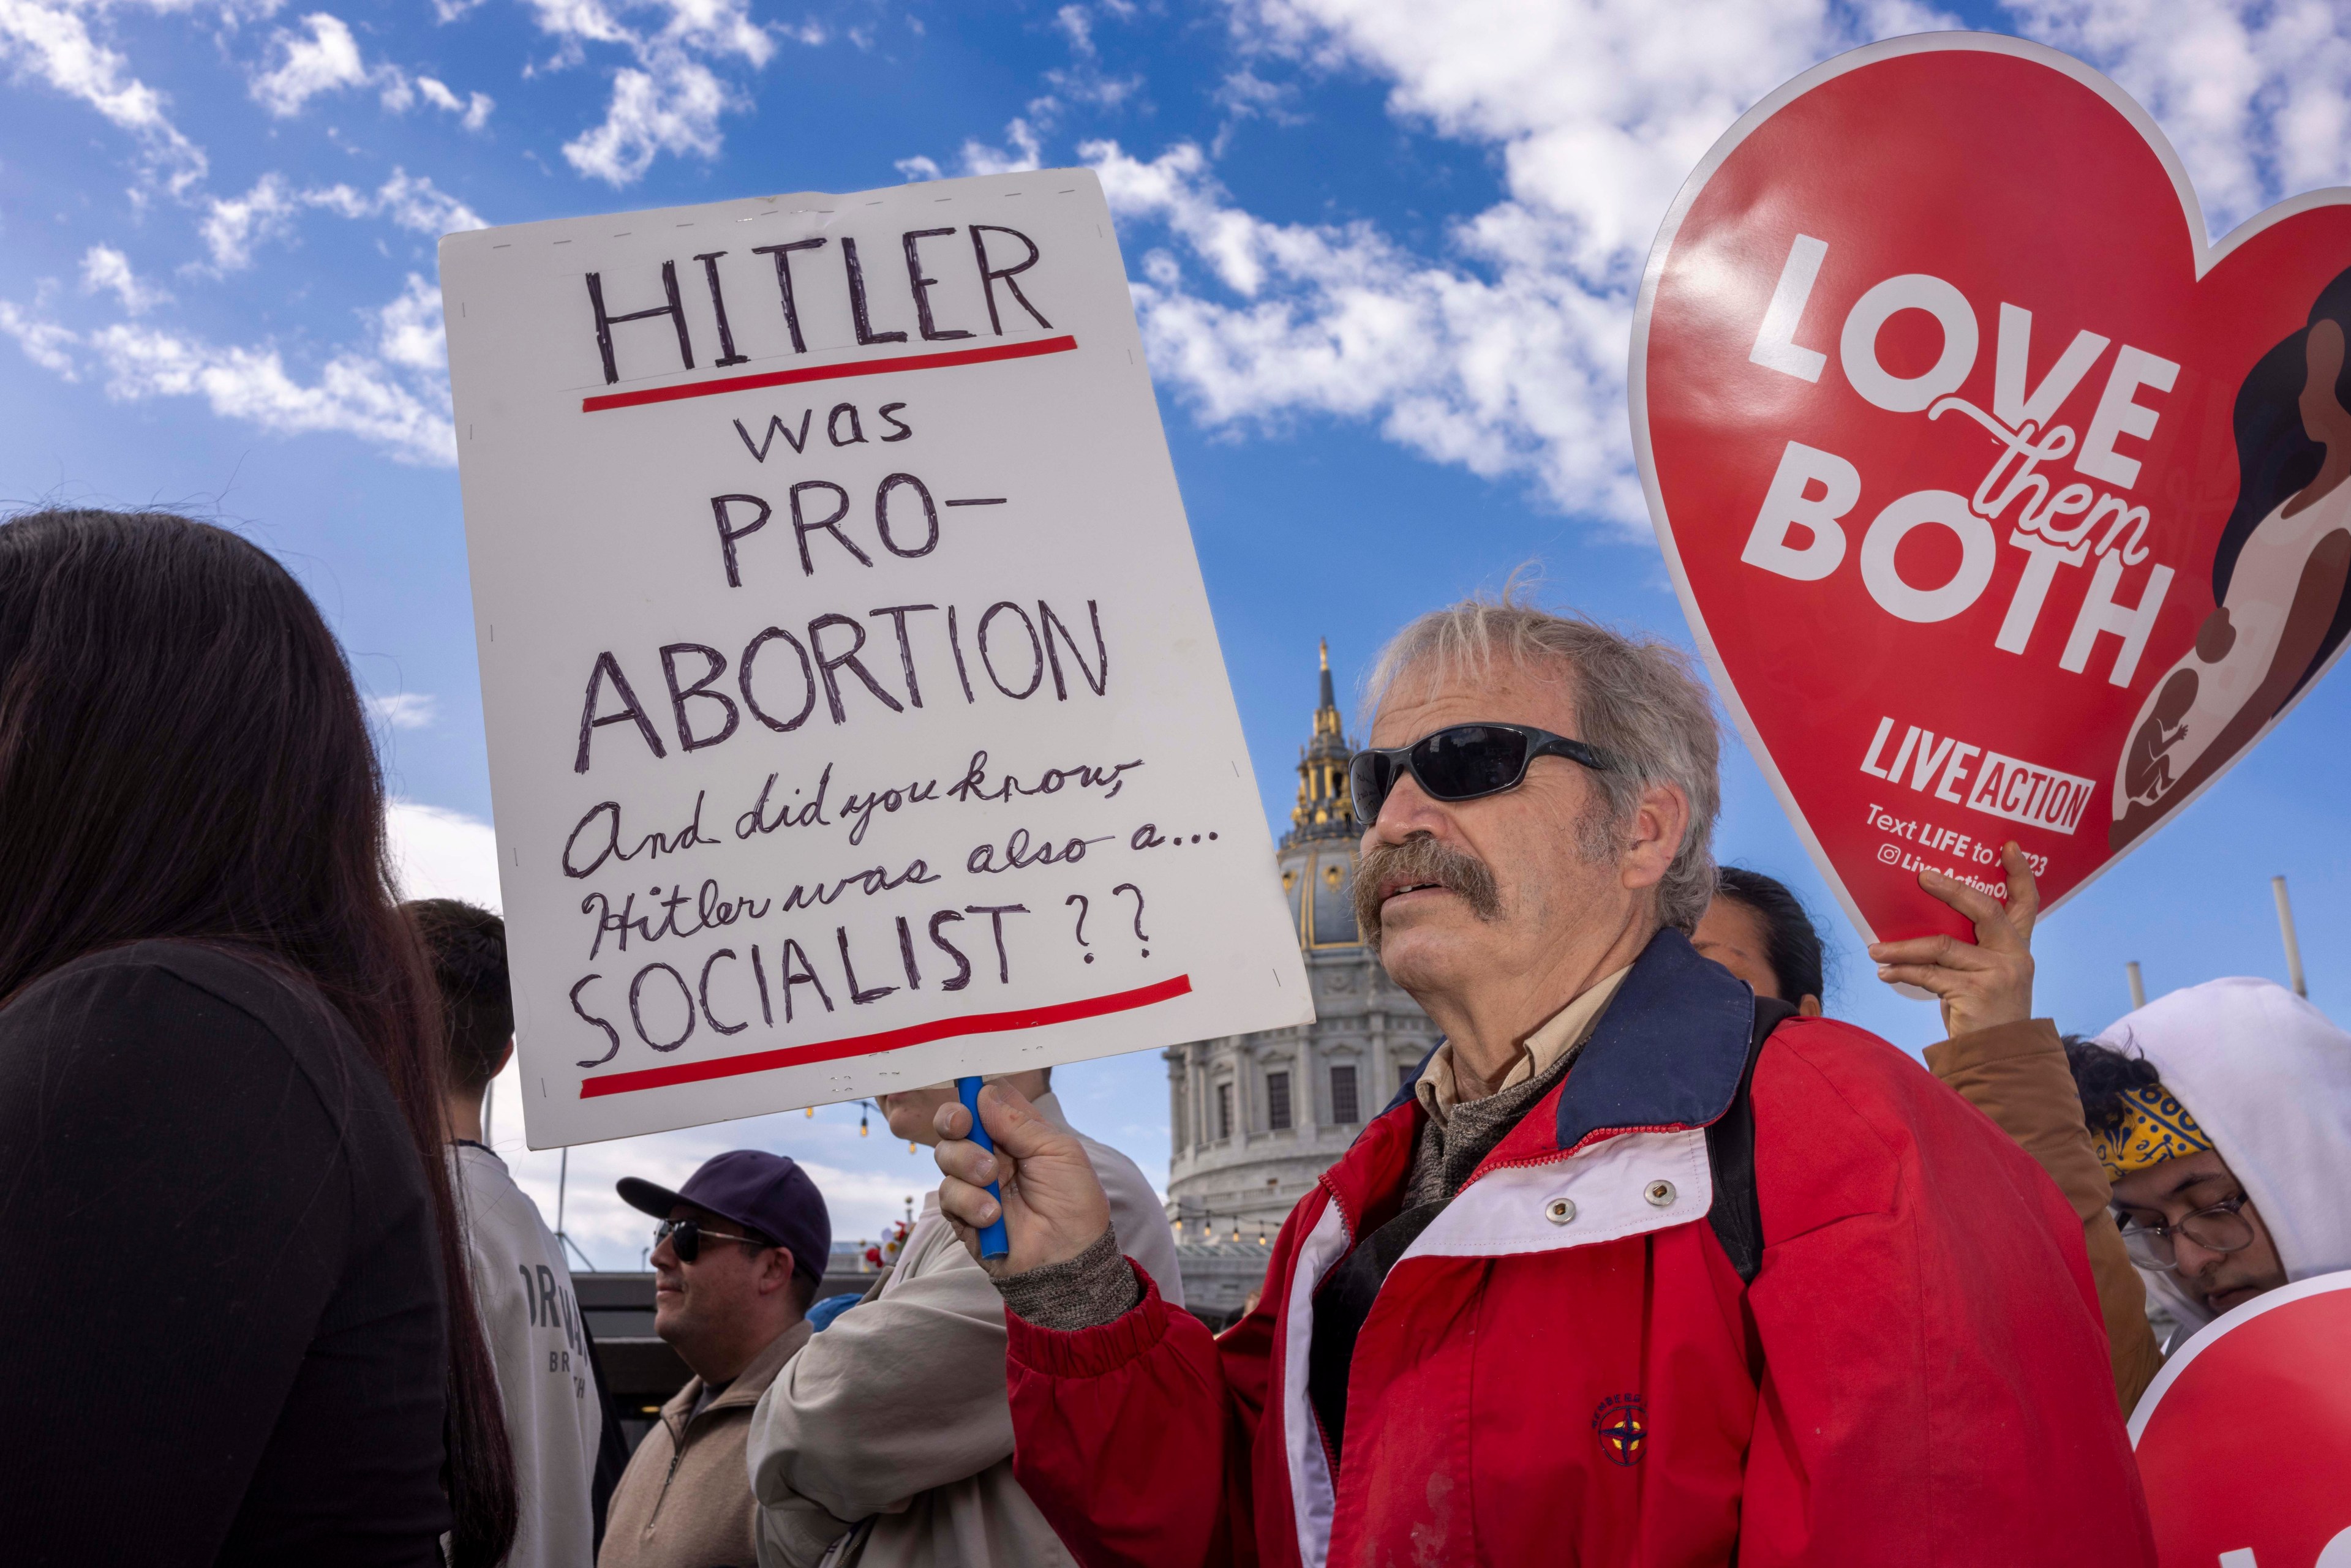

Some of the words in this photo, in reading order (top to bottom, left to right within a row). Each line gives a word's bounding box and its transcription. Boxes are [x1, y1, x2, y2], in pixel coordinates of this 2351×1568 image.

[585, 225, 1053, 386] HITLER
[1748, 233, 2181, 490] LOVE
[733, 402, 912, 463] was
[1928, 397, 2150, 566] them
[710, 473, 1007, 588] PRO-
[1741, 440, 2176, 689] BOTH
[574, 599, 1107, 776] ABORTION
[562, 790, 721, 880] And
[735, 762, 833, 839] did
[840, 775, 939, 848] you
[947, 750, 1145, 803] know,
[1860, 716, 1981, 804] LIVE
[1974, 760, 2091, 828] ACTION
[1867, 803, 1917, 840] Text
[1918, 823, 1971, 857] LIFE
[1973, 842, 1994, 865] to
[582, 879, 770, 961] Hitler
[783, 859, 942, 912] was
[967, 828, 1115, 874] also
[569, 903, 1031, 1068] SOCIALIST
